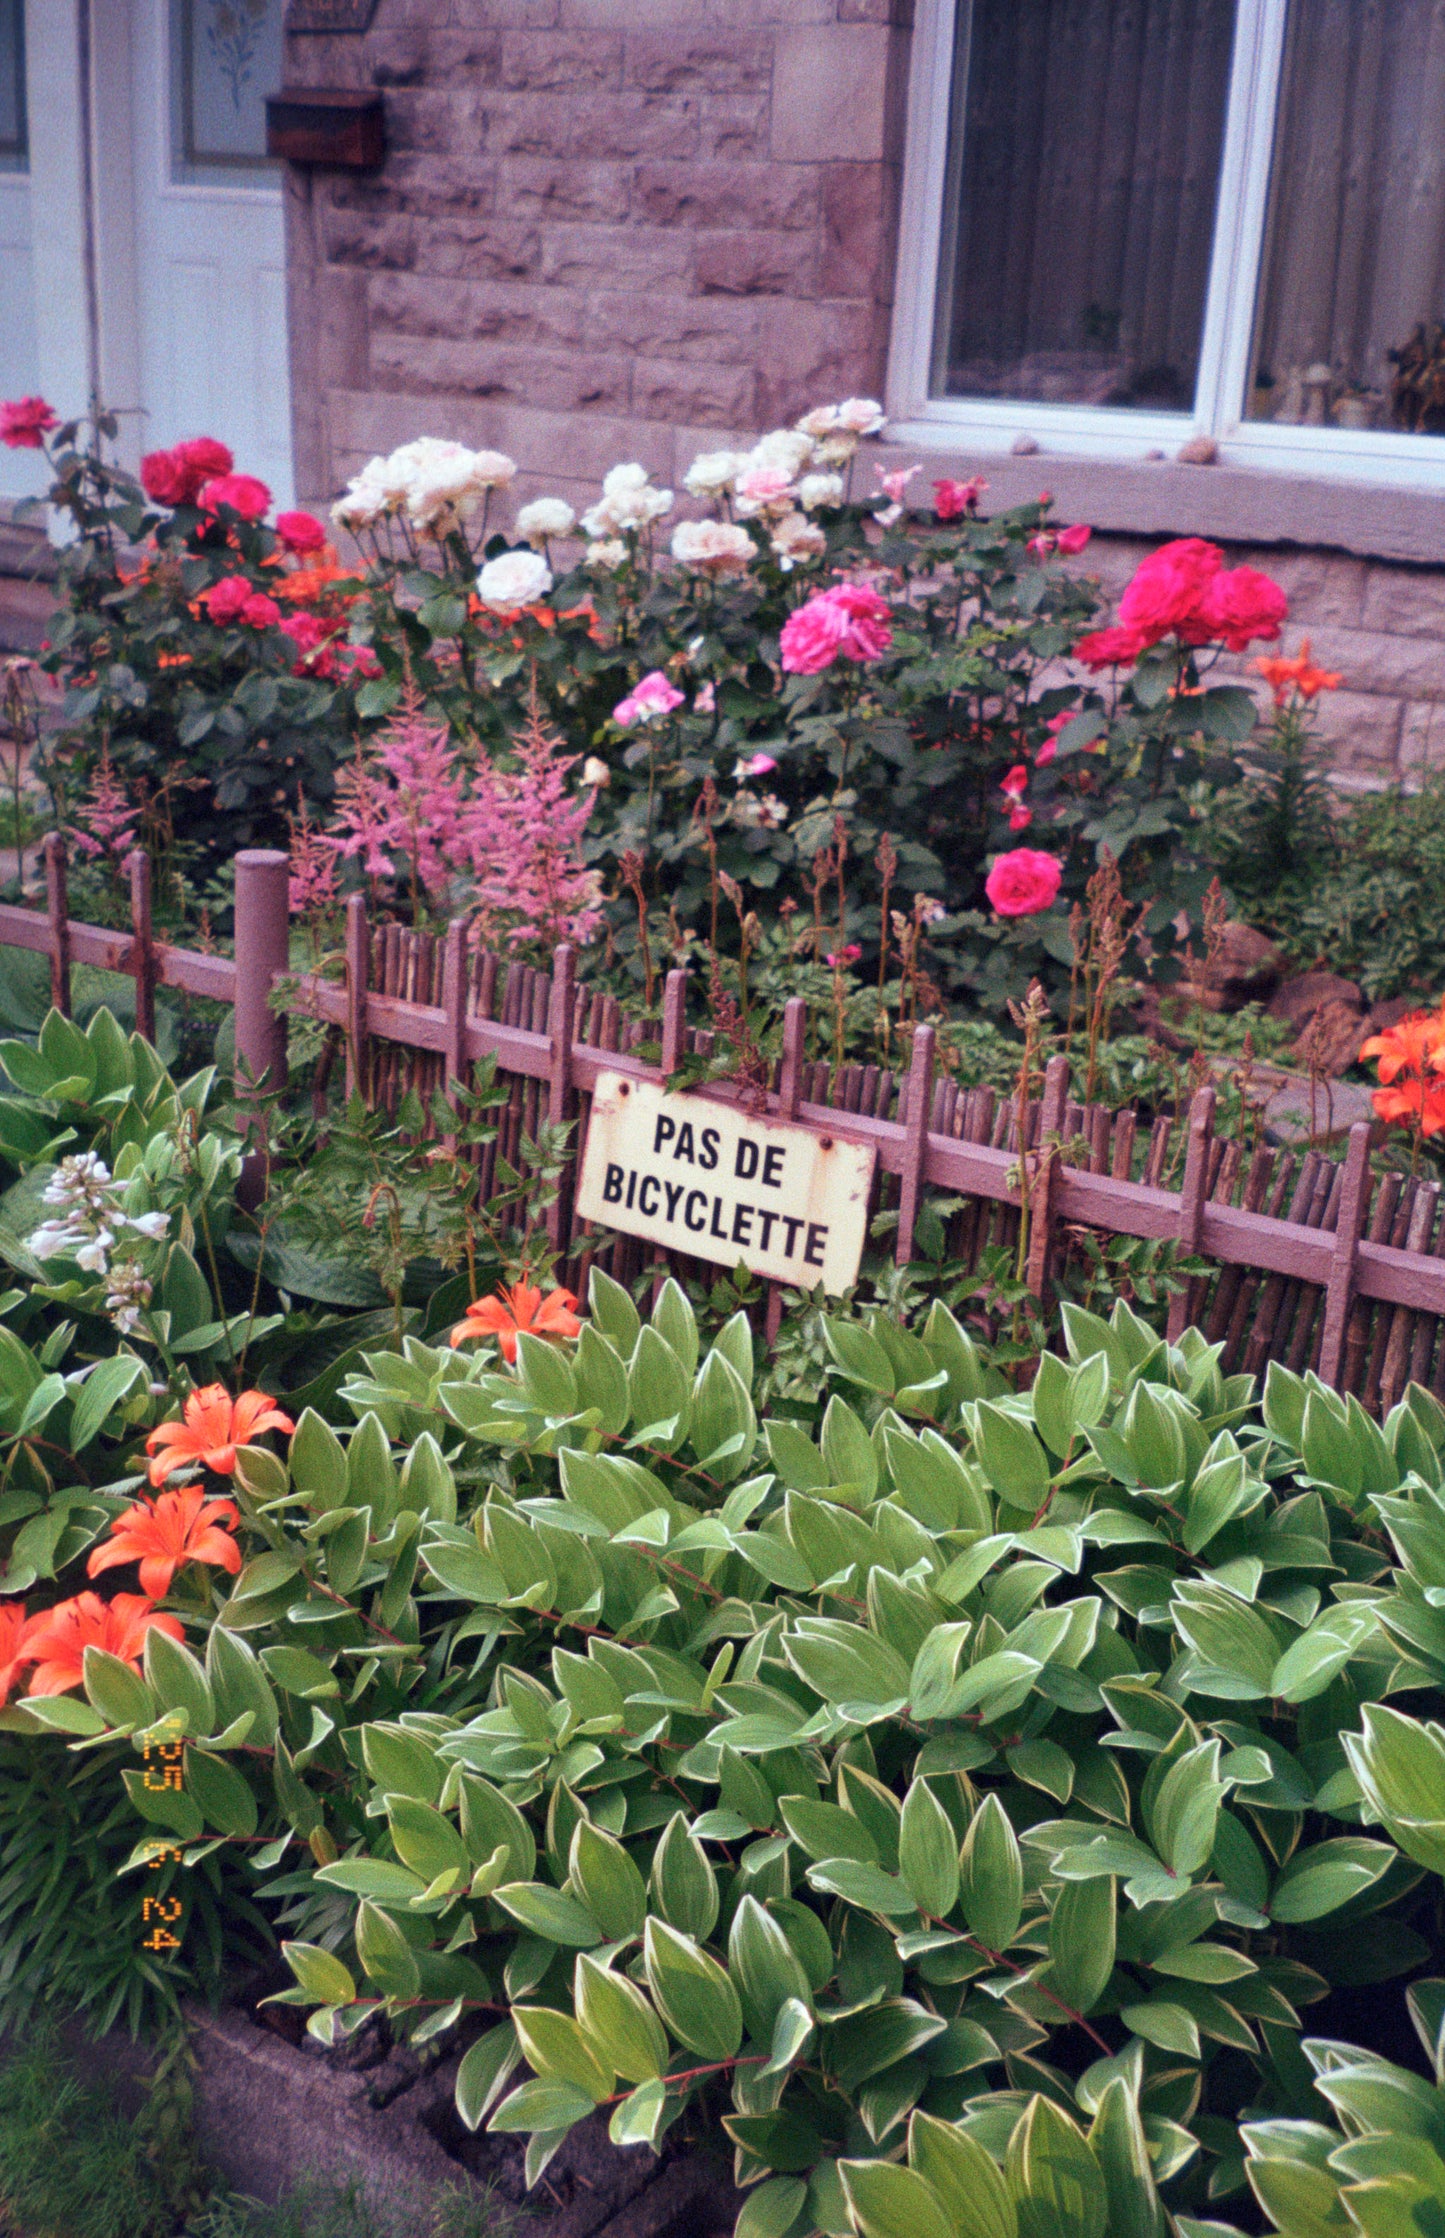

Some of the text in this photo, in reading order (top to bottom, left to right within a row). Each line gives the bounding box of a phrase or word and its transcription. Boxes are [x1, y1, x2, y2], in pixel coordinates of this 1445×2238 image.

[653, 1114, 786, 1188] PAS DE
[603, 1163, 829, 1267] BICYCLETTE
